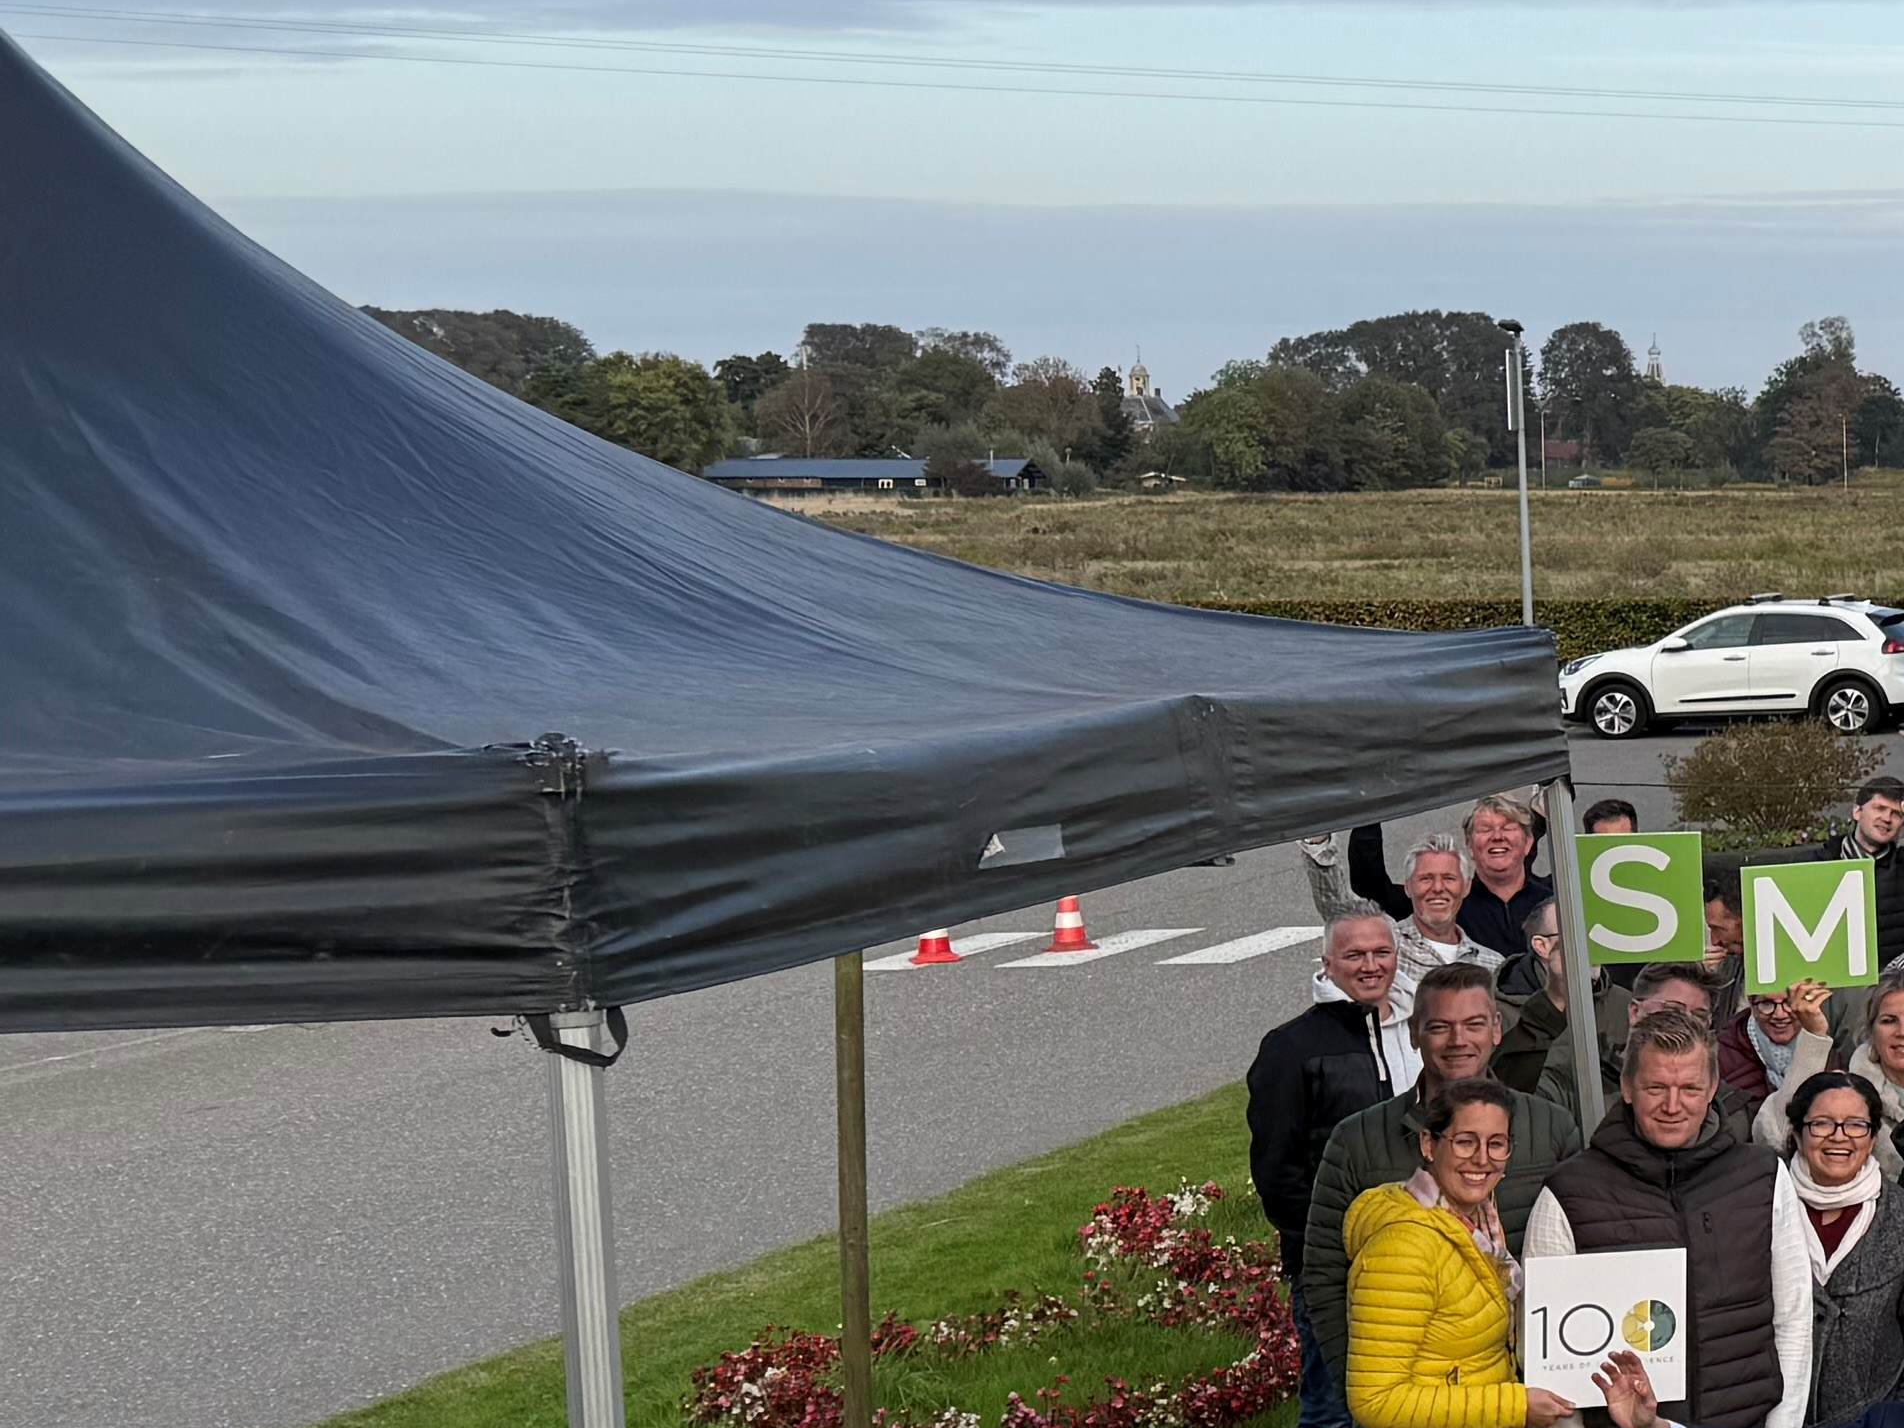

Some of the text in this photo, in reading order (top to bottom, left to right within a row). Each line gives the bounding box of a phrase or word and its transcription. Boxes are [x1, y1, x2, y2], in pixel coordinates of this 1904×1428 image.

[1589, 844, 1678, 953] S
[1753, 869, 1868, 984] M
[1542, 1363, 1575, 1372] YEARS
